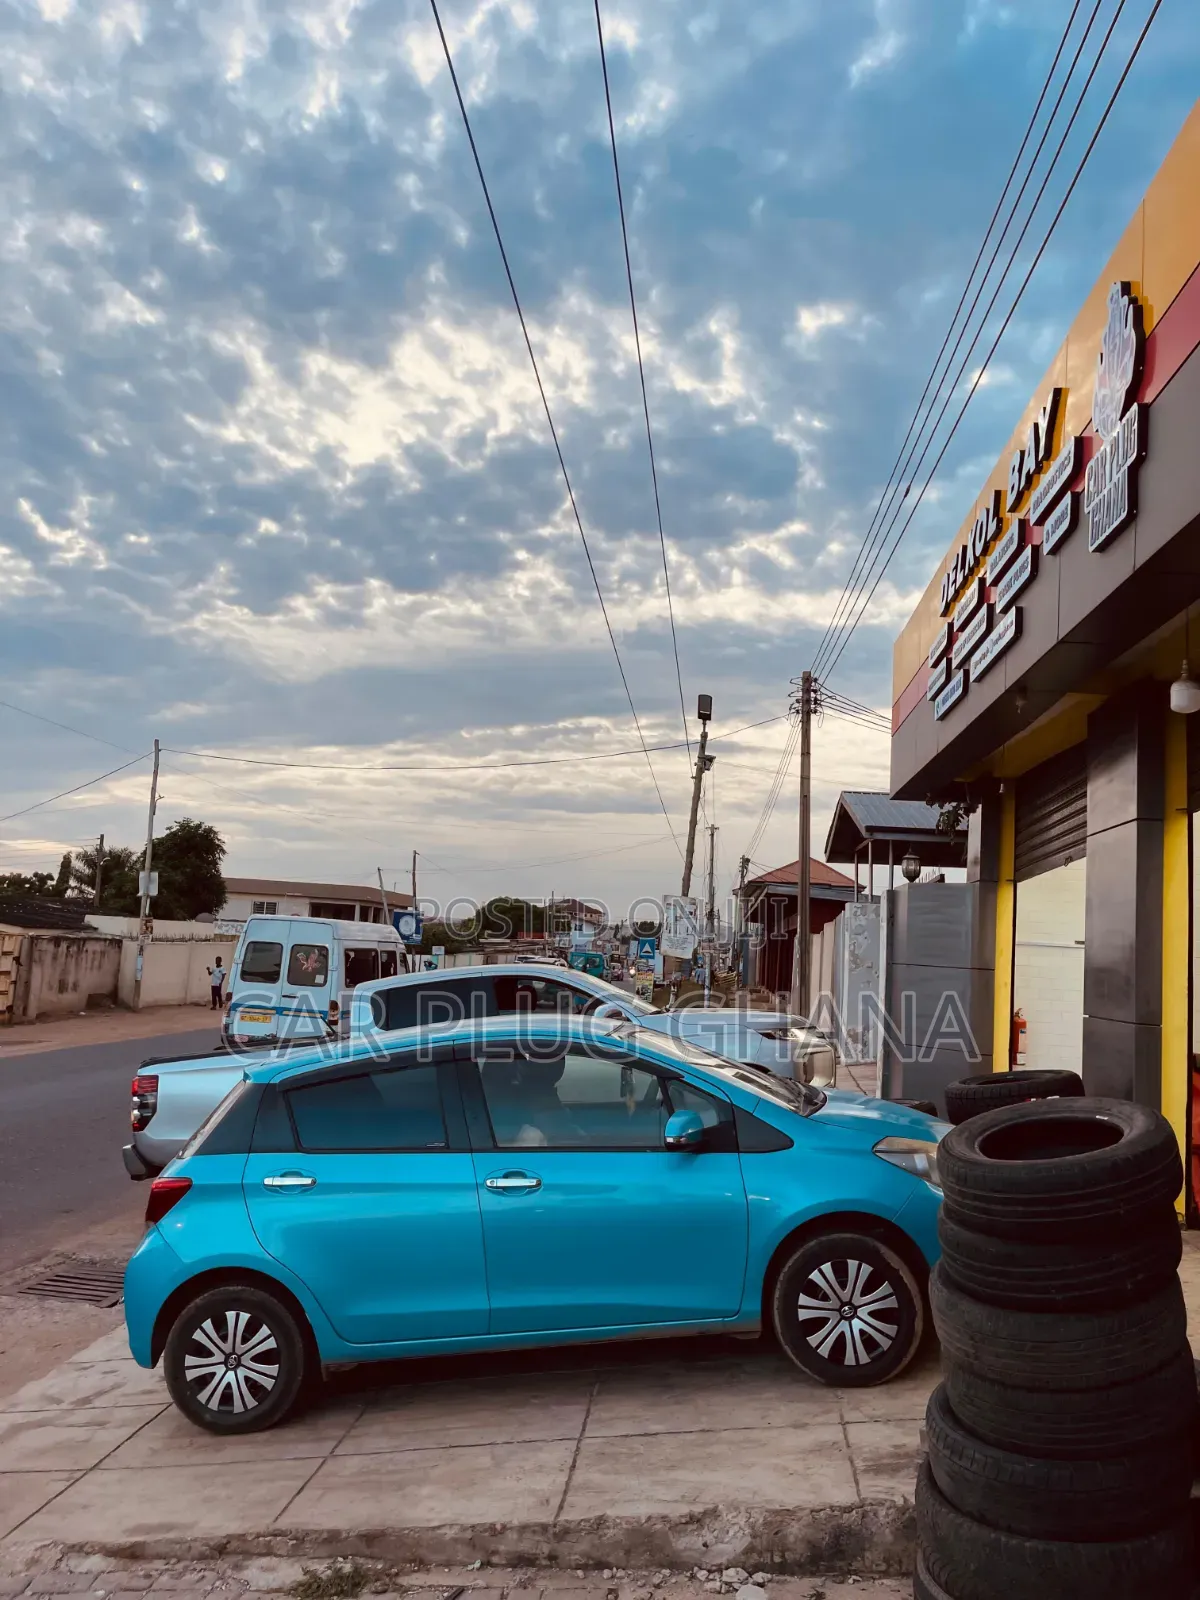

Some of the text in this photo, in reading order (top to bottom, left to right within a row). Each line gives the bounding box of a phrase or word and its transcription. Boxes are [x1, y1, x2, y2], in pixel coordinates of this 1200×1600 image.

[940, 490, 1001, 615] DELKOL
[1007, 388, 1057, 512] BAY
[1086, 408, 1136, 508] CAR PLUG
[1089, 467, 1127, 547] GHANA
